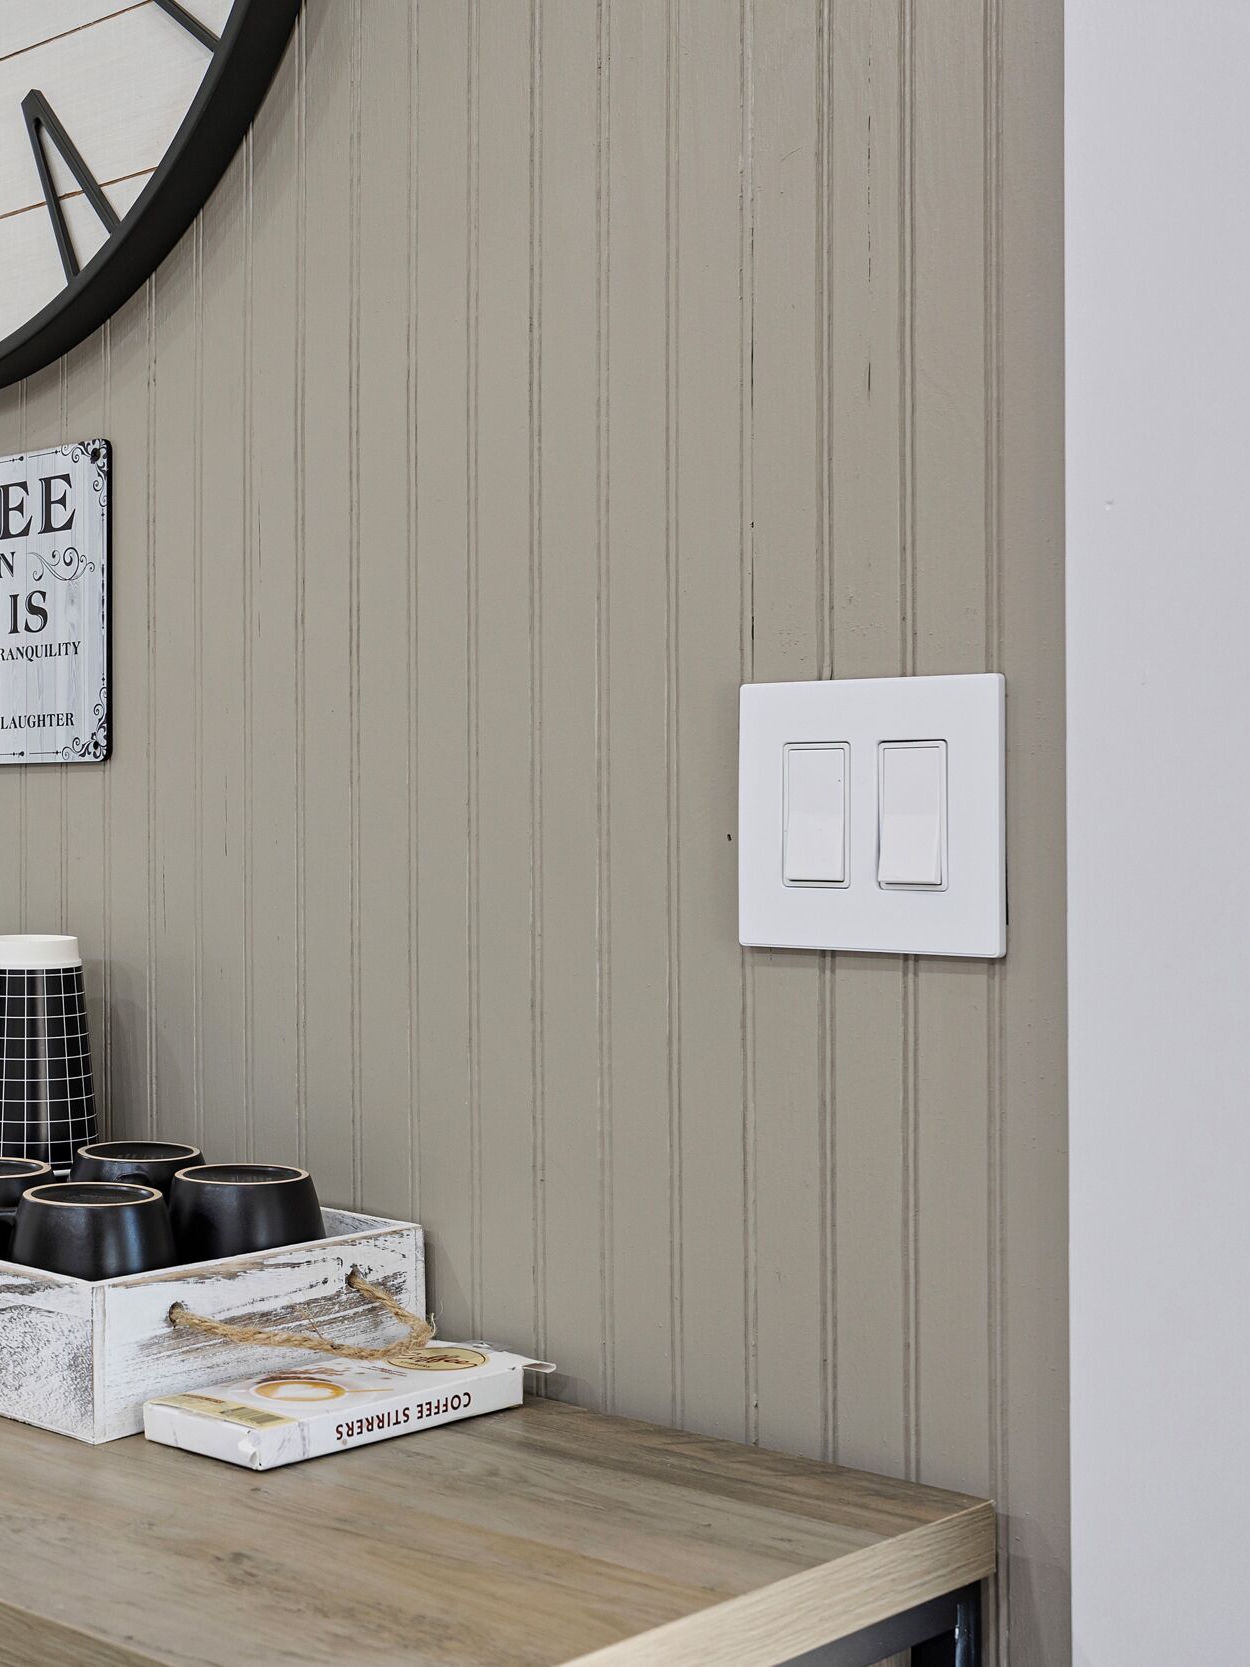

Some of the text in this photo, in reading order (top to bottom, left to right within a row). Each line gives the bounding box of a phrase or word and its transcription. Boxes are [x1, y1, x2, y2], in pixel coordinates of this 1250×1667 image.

[8, 590, 49, 635] IS
[0, 712, 75, 730] LAUGHTER
[335, 1391, 472, 1441] COFFEE STIRRERS
